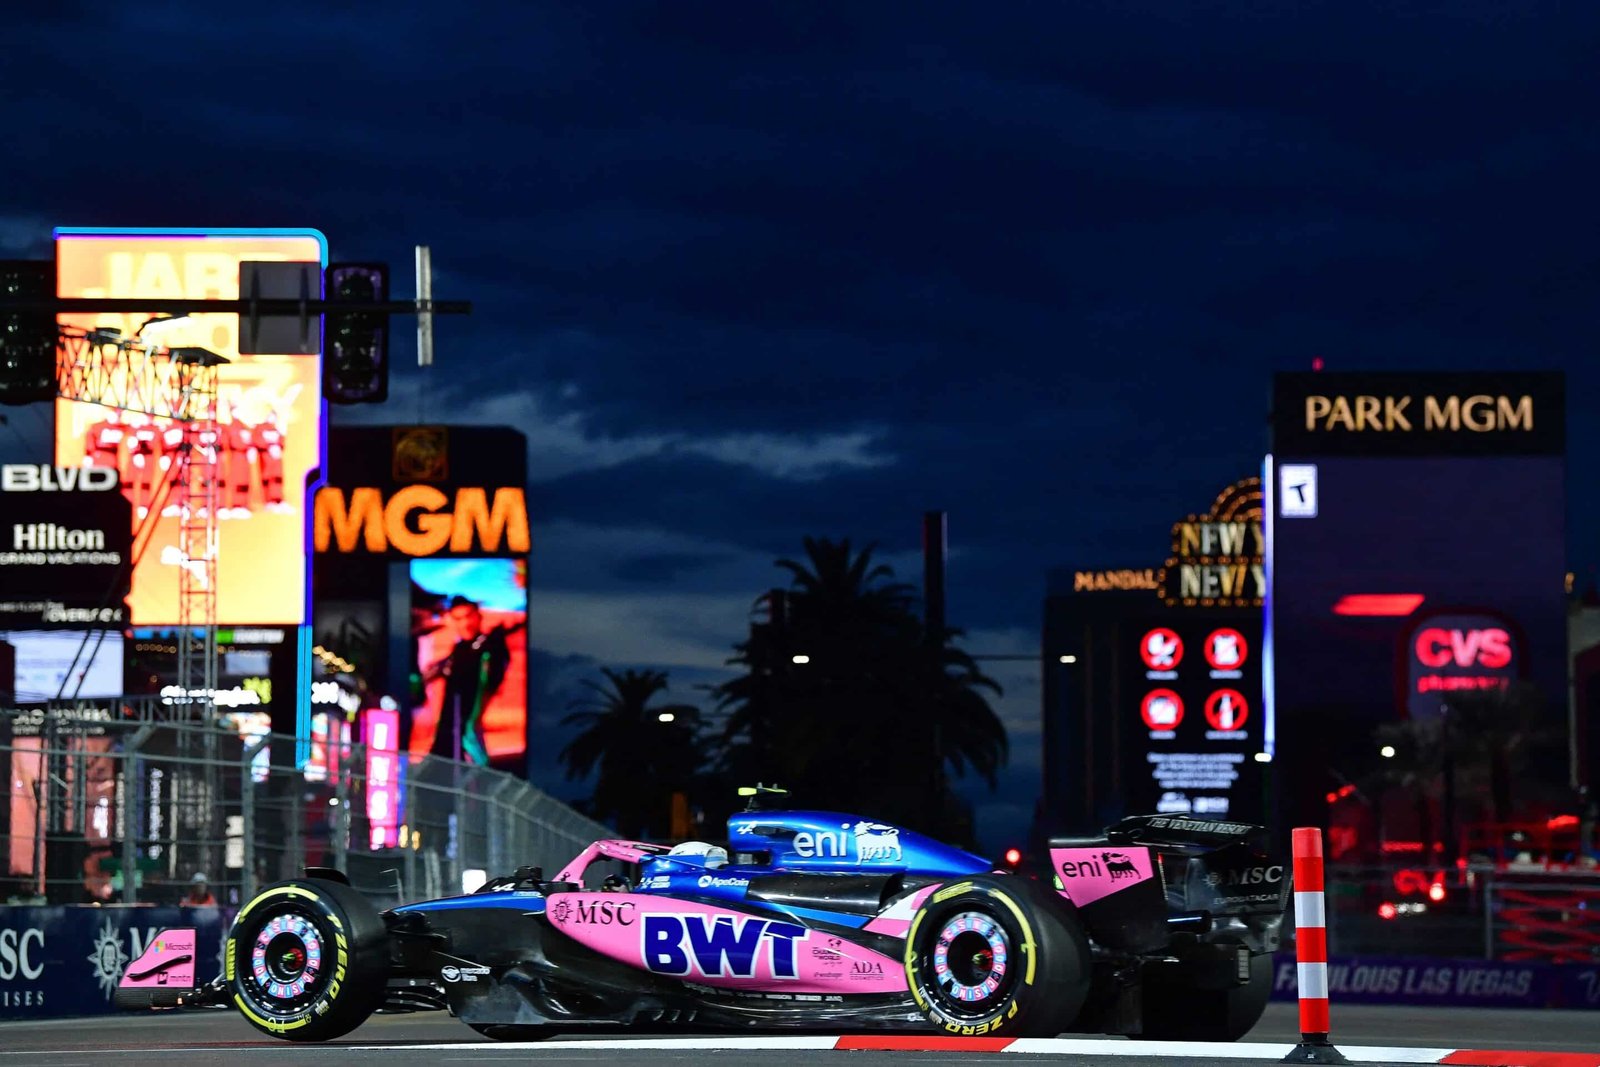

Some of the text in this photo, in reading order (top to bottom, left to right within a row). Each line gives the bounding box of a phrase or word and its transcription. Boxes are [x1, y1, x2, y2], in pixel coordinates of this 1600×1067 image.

[1304, 395, 1533, 432] PARK MGM
[2, 464, 118, 492] BLVD
[313, 484, 531, 556] MGM
[13, 523, 105, 550] Hilton
[1181, 522, 1247, 557] NEW
[47, 552, 121, 565] VACATIONS
[1180, 564, 1247, 597] NEW
[1415, 628, 1512, 669] CVS
[1147, 817, 1170, 828] THE
[1168, 819, 1216, 832] VENETIAN
[792, 823, 849, 858] eni
[1062, 855, 1102, 878] eni
[711, 877, 749, 887] ApeCoin
[575, 901, 636, 926] MSC
[641, 912, 812, 980] BWT
[328, 933, 348, 1000] ZERO
[849, 962, 884, 974] ADA
[952, 979, 997, 999] CASINO
[1403, 966, 1453, 995] LAS
[1456, 968, 1534, 997] VEGAS
[3, 991, 44, 1007] ISES
[945, 1015, 1004, 1036] ZERO
